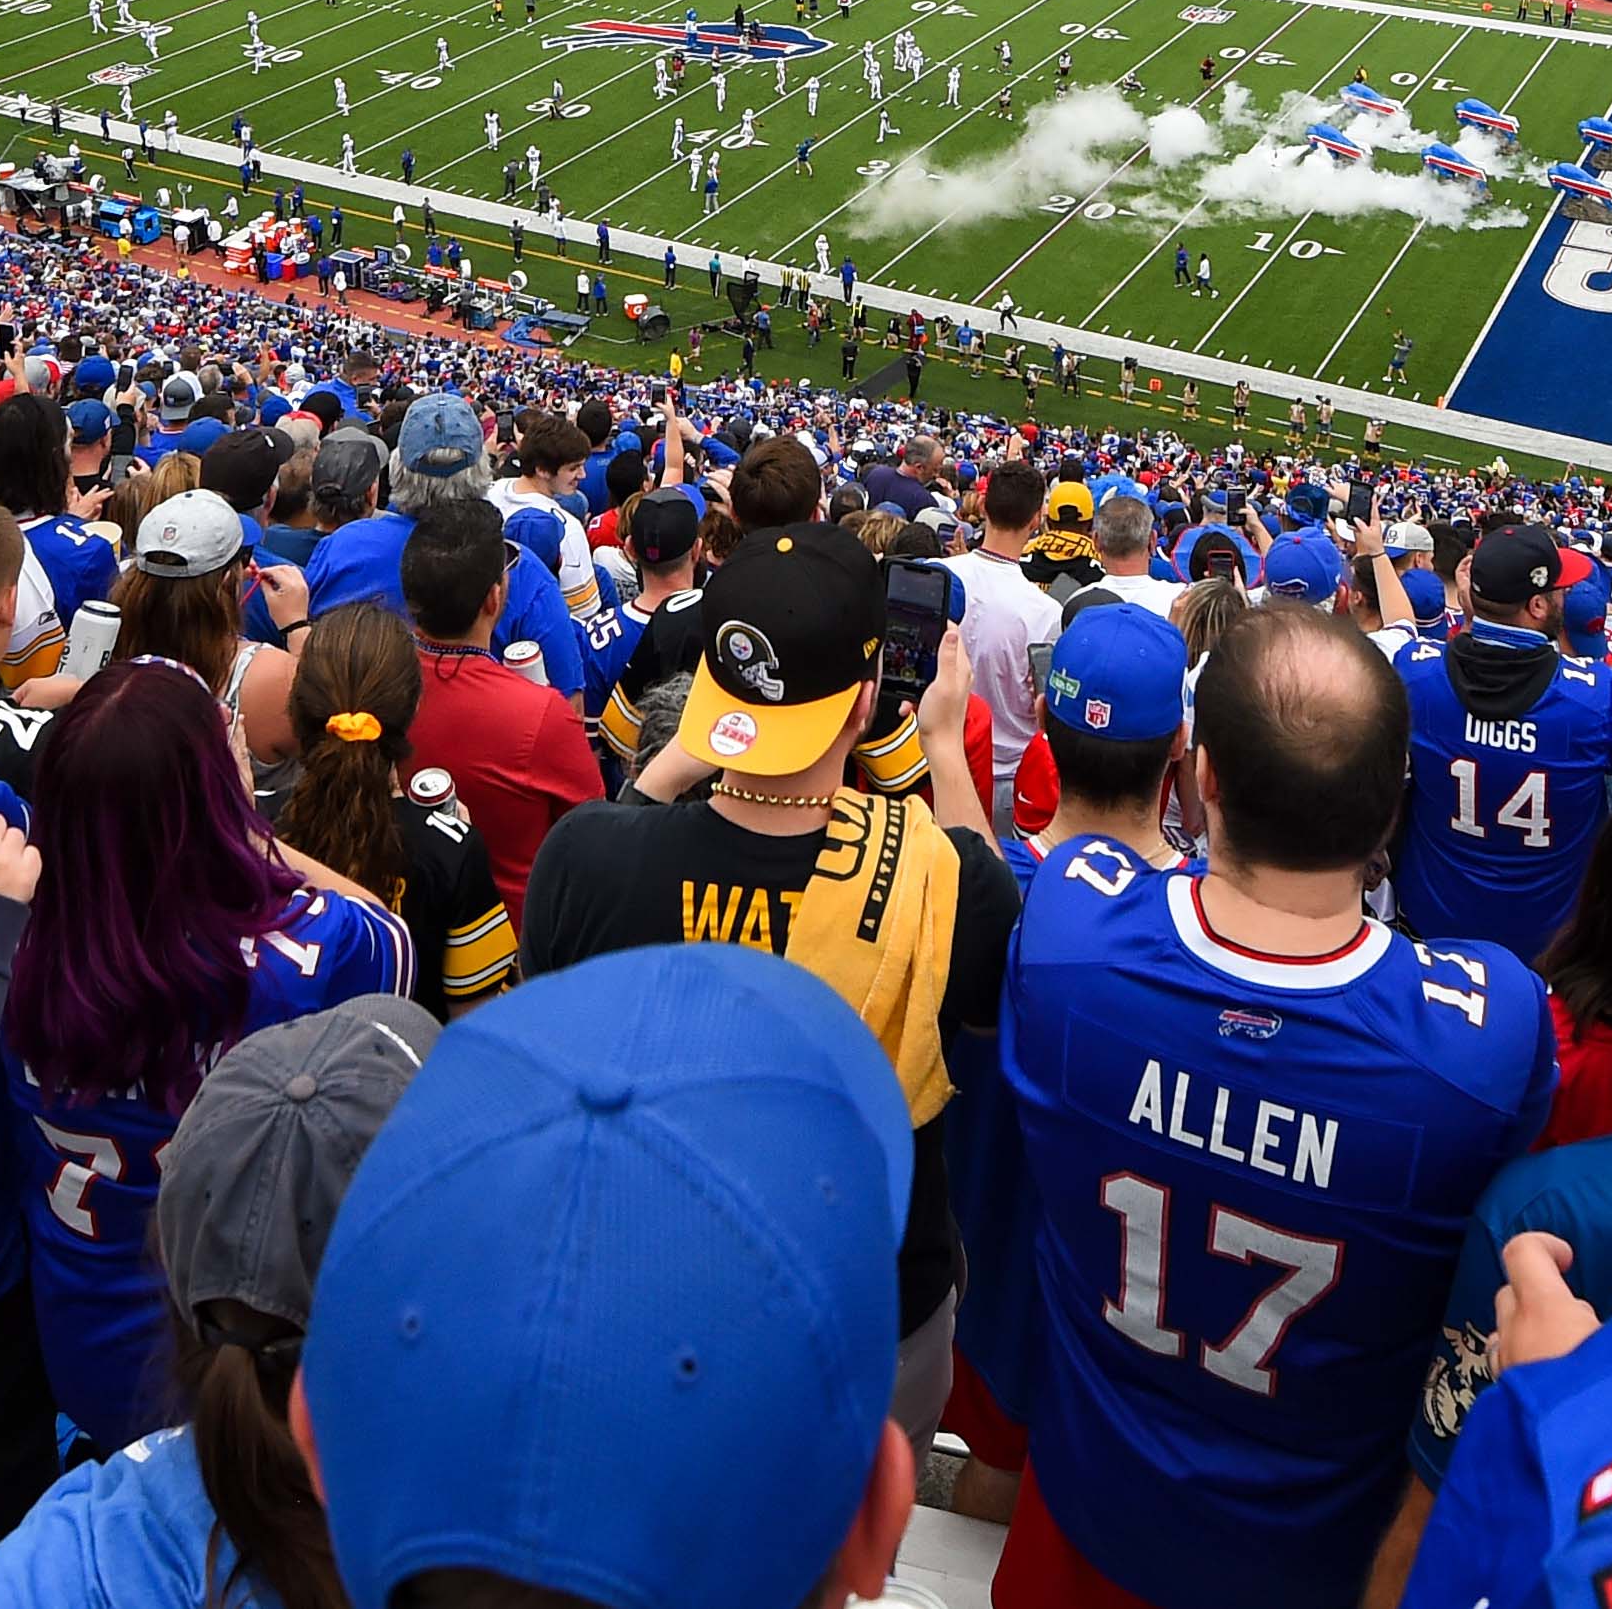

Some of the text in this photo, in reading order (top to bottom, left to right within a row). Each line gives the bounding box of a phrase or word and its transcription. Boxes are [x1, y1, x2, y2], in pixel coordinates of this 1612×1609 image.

[380, 71, 443, 90] 40
[525, 97, 592, 119] 50
[684, 128, 753, 150] 40
[1037, 194, 1117, 220] 20
[1244, 231, 1324, 259] 10
[1464, 711, 1537, 754] DIGGS
[1449, 758, 1552, 848] 14
[1064, 840, 1136, 896] 17
[863, 917, 876, 929] A
[1411, 942, 1486, 1028] 17
[1128, 1059, 1339, 1189] ALLEN
[36, 1114, 124, 1238] 7
[1100, 1170, 1345, 1398] 17
